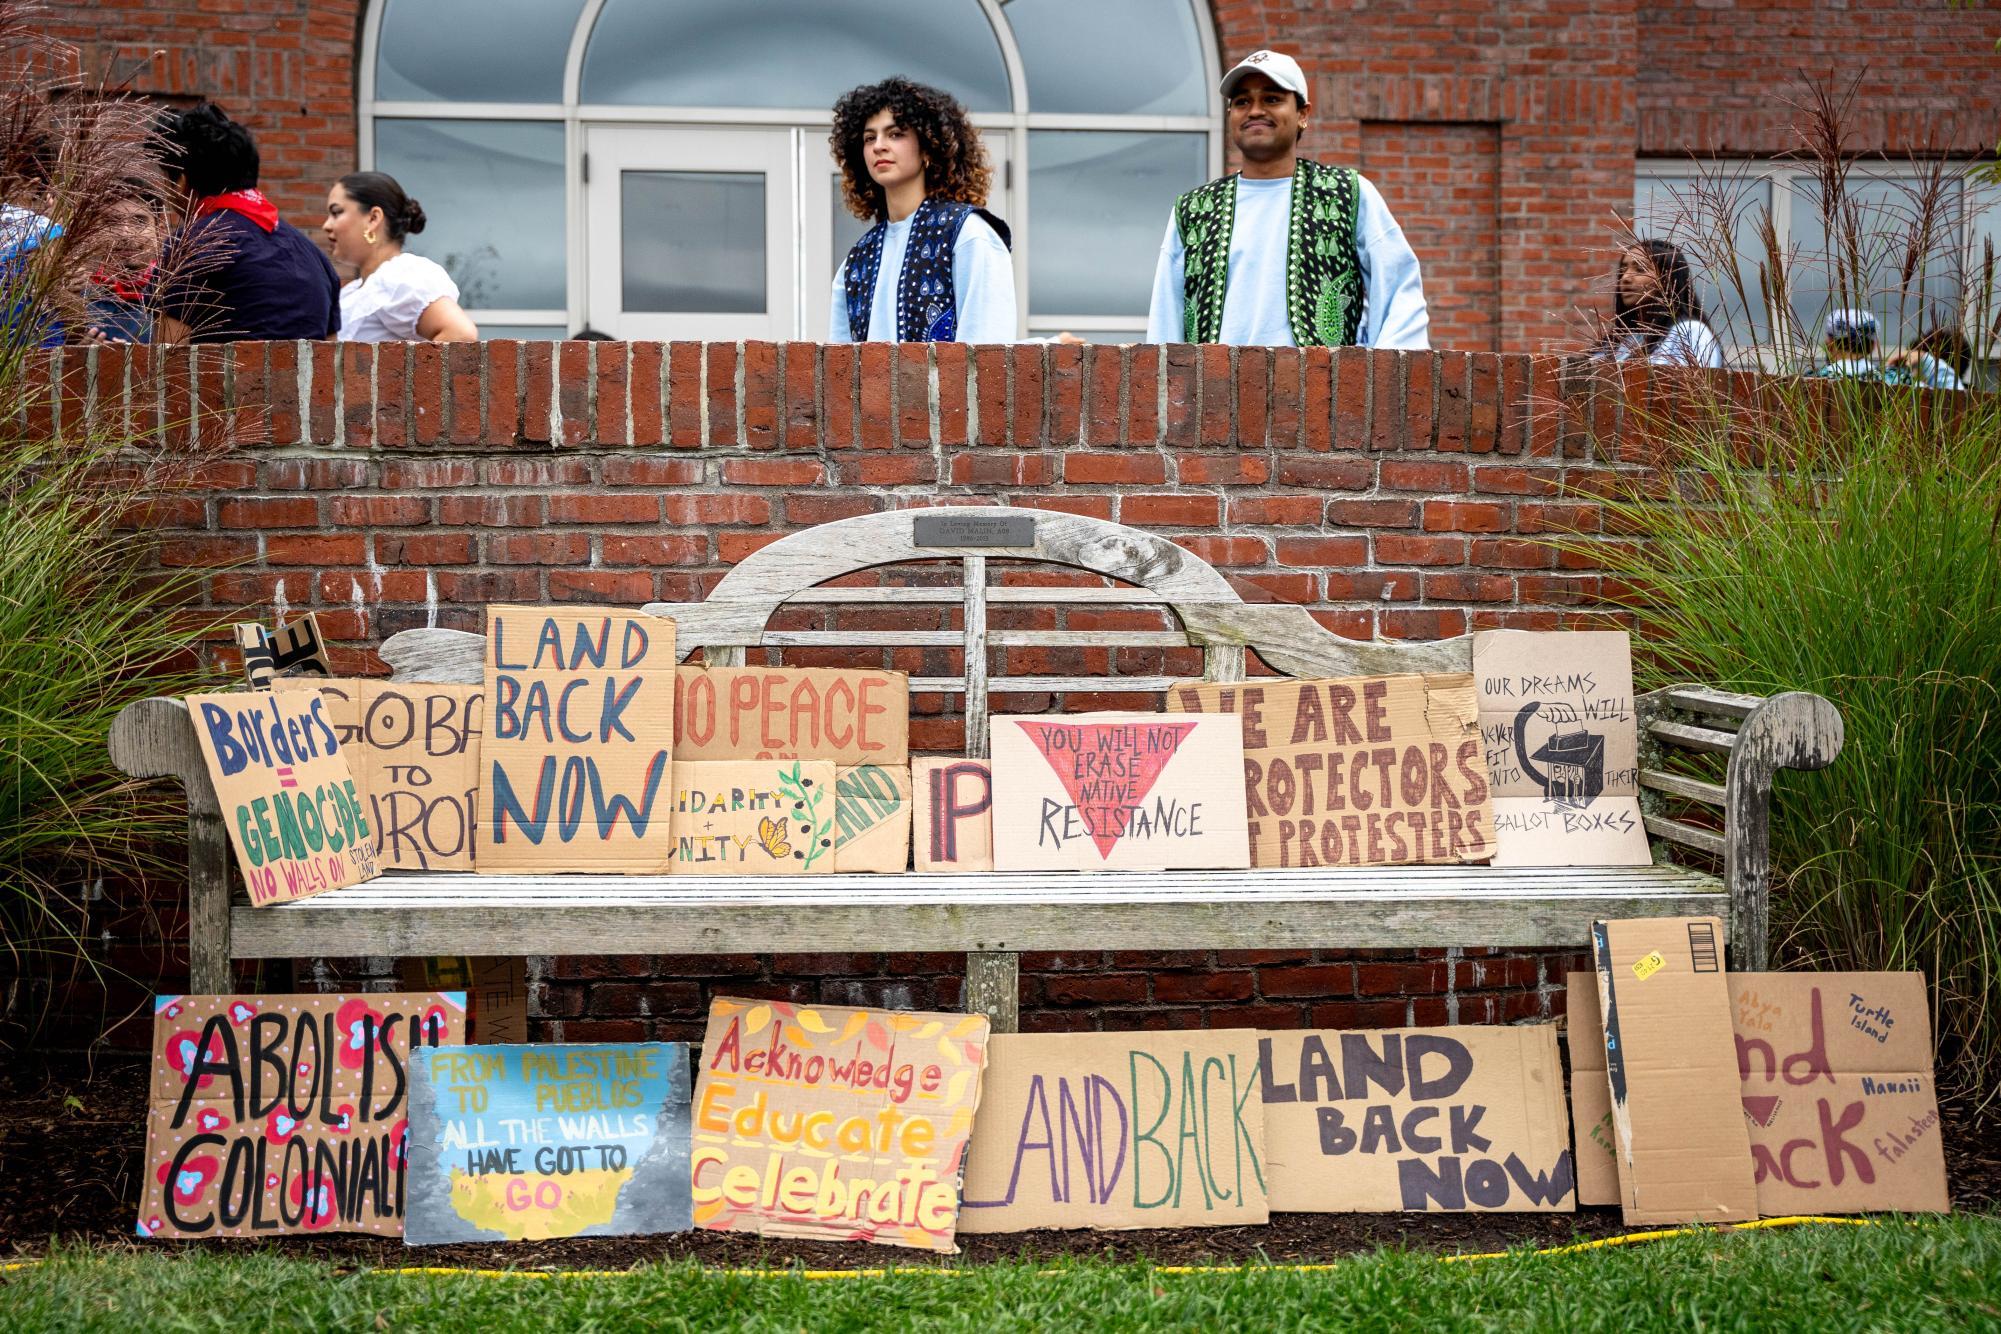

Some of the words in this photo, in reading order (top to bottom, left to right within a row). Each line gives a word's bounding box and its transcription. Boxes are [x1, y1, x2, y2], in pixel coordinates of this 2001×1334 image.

[973, 520, 997, 528] Memory
[495, 616, 649, 672] LAND
[1485, 678, 1516, 697] OUR
[1521, 671, 1598, 698] DREAMS
[496, 675, 644, 744] BACK
[730, 674, 889, 751] PEACE
[1290, 680, 1392, 746] ARE
[1582, 694, 1630, 723] WILL
[200, 696, 338, 776] Borders
[1040, 726, 1083, 756] YOU
[1097, 726, 1142, 757] WILL
[1147, 726, 1185, 754] NOT
[1480, 723, 1515, 747] NEVER
[1074, 752, 1142, 780] ERASE
[1486, 748, 1511, 766] FIT
[382, 764, 433, 787] TO
[1604, 767, 1639, 790] THEIR
[492, 749, 668, 846] NOW
[670, 787, 785, 814] IDARITY
[1038, 795, 1203, 851] RESISTANCE
[1279, 808, 1486, 868] PROTESTERS
[1563, 809, 1636, 834] BOXES
[348, 840, 378, 865] STOLEN
[250, 866, 277, 902] NO
[280, 856, 328, 897] WALLS
[328, 854, 346, 884] ON
[357, 861, 376, 880] LAND
[1848, 992, 1895, 1029] Turtle
[1850, 1014, 1889, 1044] Island
[431, 1051, 506, 1084] FROM
[521, 1047, 658, 1084] PALESTINE
[710, 1015, 943, 1104] Acknowledge
[1258, 1033, 1474, 1104] LAND
[448, 1085, 489, 1114] TO
[536, 1082, 645, 1113] PUEBLOS
[1861, 1076, 1921, 1096] Hawaii
[442, 1117, 500, 1151] ALL
[498, 1117, 554, 1145] THE
[558, 1114, 649, 1141] WALLS
[697, 1082, 936, 1158] Educate
[1315, 1104, 1492, 1156] BACK
[467, 1147, 526, 1177] HAVE
[535, 1146, 592, 1176] GOT
[593, 1145, 628, 1173] TO
[505, 1178, 563, 1212] GO
[691, 1147, 959, 1238] Celebrate
[1397, 1148, 1574, 1210] NOW
